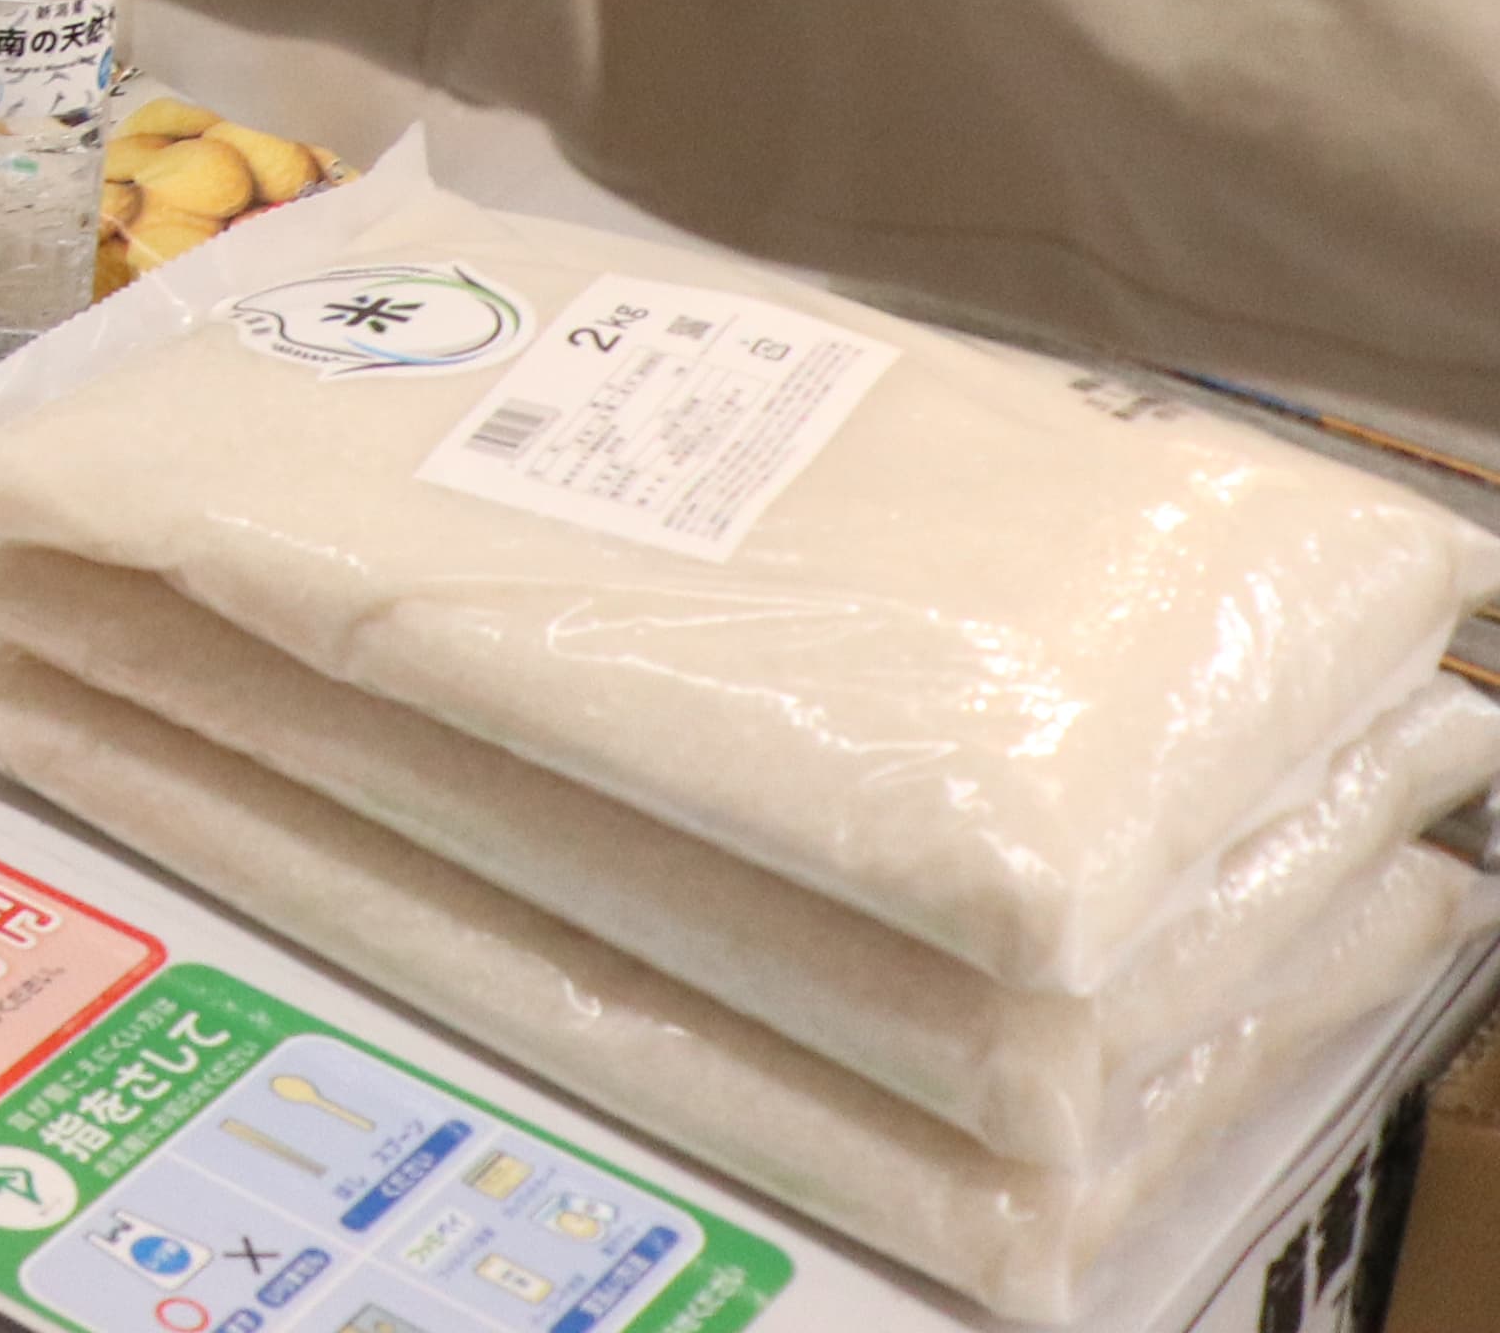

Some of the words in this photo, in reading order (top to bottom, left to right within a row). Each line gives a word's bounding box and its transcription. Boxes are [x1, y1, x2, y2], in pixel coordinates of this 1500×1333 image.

[39, 1011, 231, 1164] 指をさして
